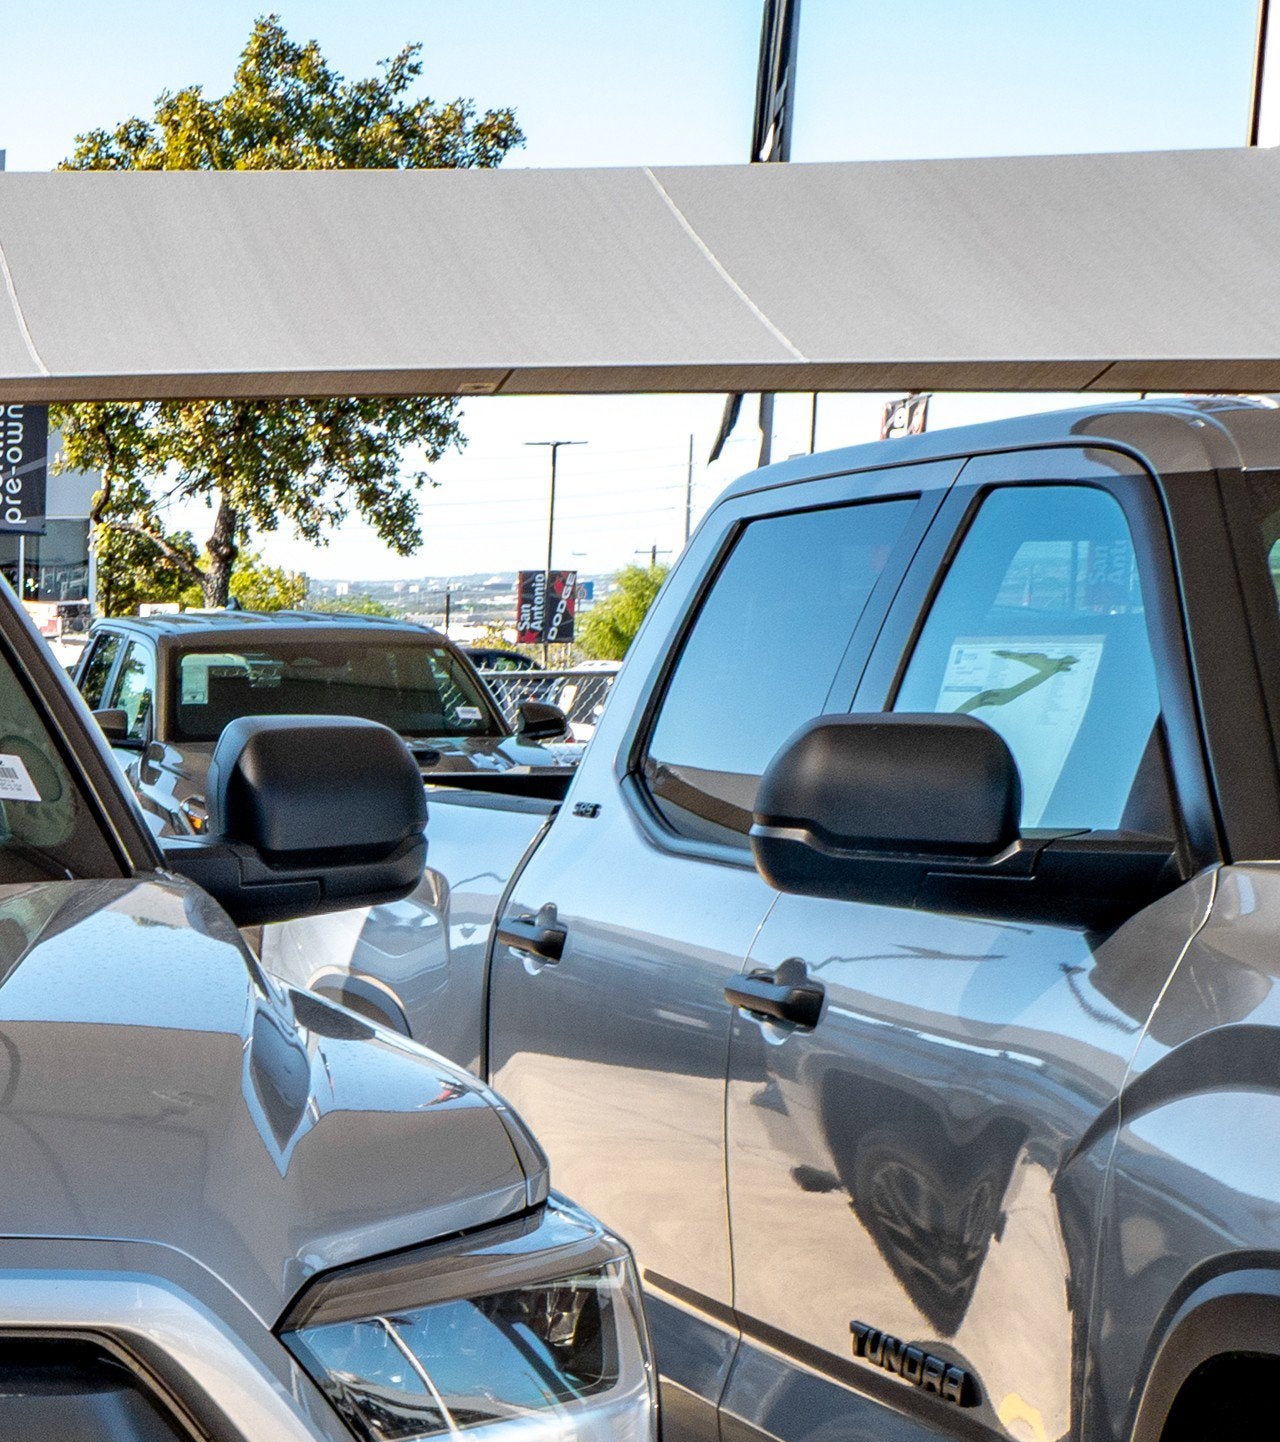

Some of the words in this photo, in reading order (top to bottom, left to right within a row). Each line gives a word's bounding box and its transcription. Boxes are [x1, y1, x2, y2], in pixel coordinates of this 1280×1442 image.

[4, 404, 27, 525] pre-own
[517, 603, 532, 632] San
[530, 573, 545, 632] Antonio
[547, 572, 577, 641] DODGE
[849, 1320, 983, 1408] TUNDRA
